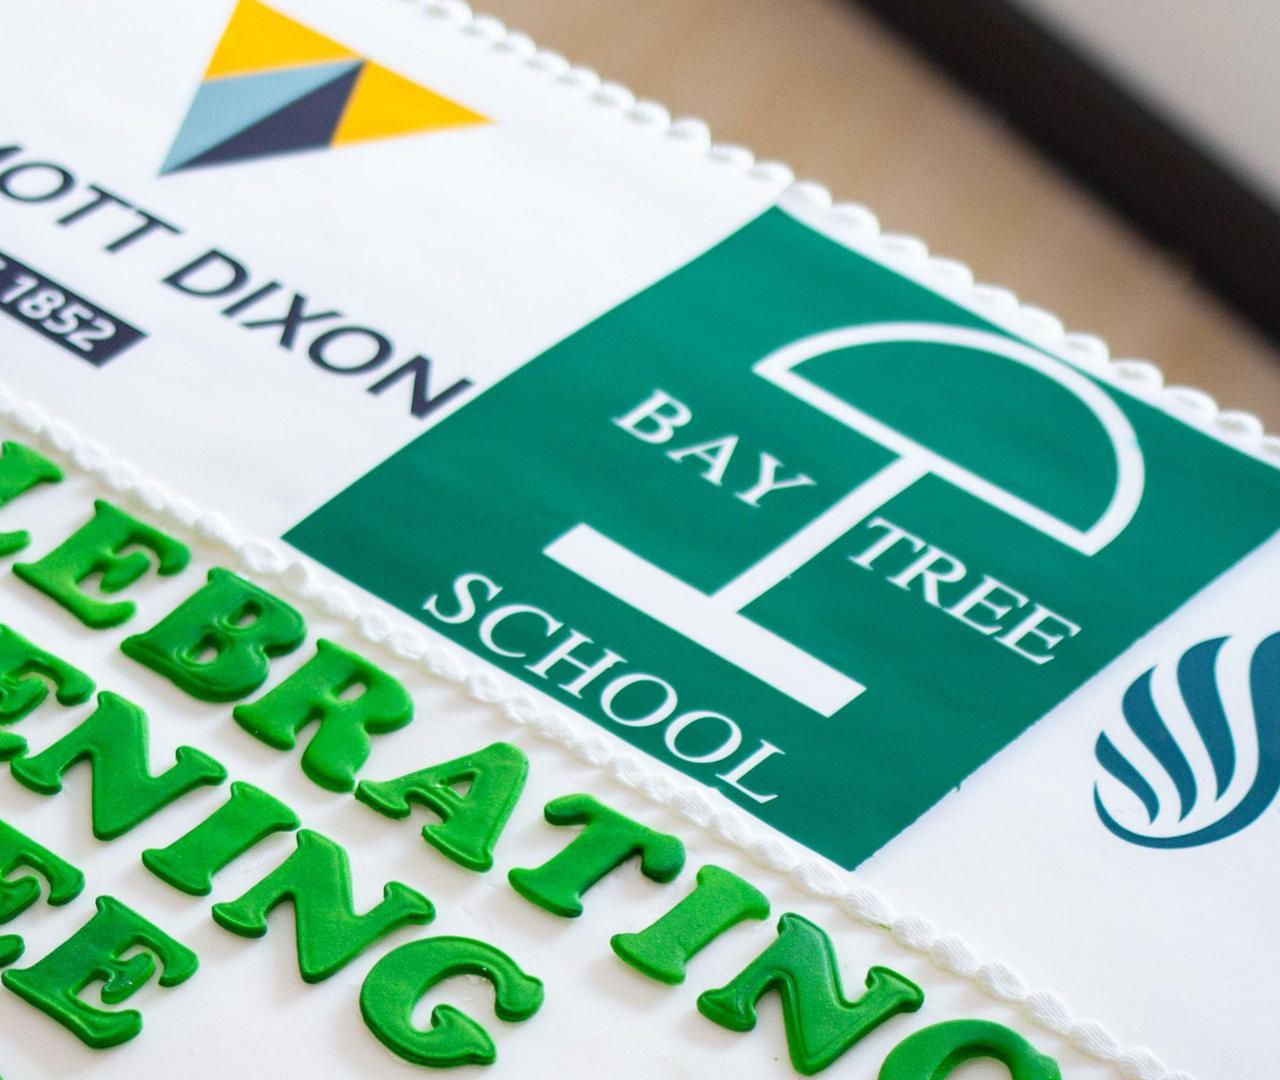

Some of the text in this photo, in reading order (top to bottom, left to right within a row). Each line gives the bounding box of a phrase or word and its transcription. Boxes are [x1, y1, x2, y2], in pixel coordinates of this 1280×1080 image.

[1, 271, 118, 354] 1852
[163, 251, 473, 420] DIXON
[612, 390, 1080, 665] BAY TREE
[423, 572, 789, 803] SCHOOL
